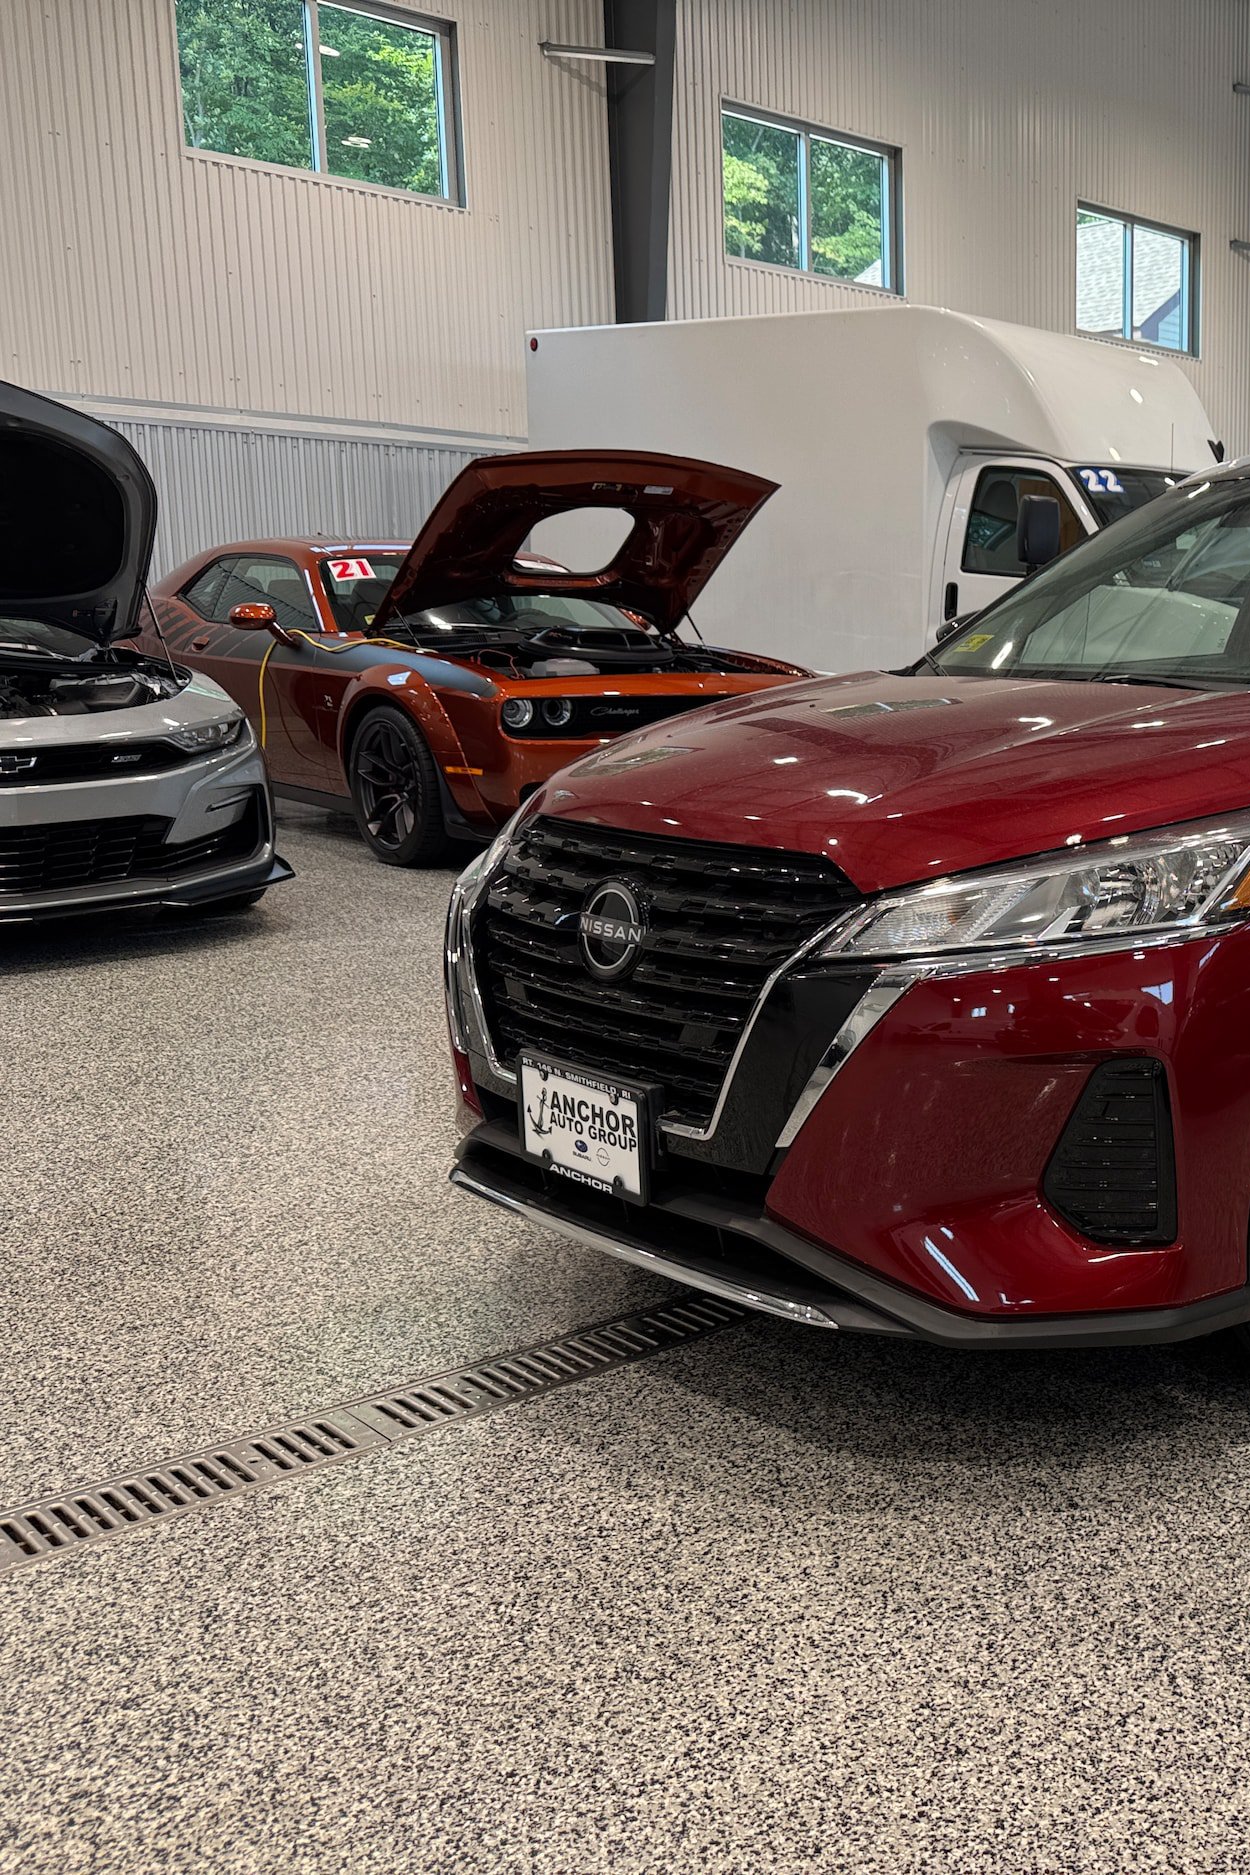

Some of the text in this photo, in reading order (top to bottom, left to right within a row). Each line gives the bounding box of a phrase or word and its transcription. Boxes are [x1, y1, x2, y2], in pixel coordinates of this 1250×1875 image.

[1080, 469, 1124, 492] 22
[332, 561, 369, 578] 21
[580, 916, 641, 942] NISSAN
[622, 1090, 631, 1100] RI
[550, 1091, 636, 1138] ANCHOR
[550, 1111, 637, 1152] AUTO GROUP
[550, 1163, 613, 1194] ANCHOR
